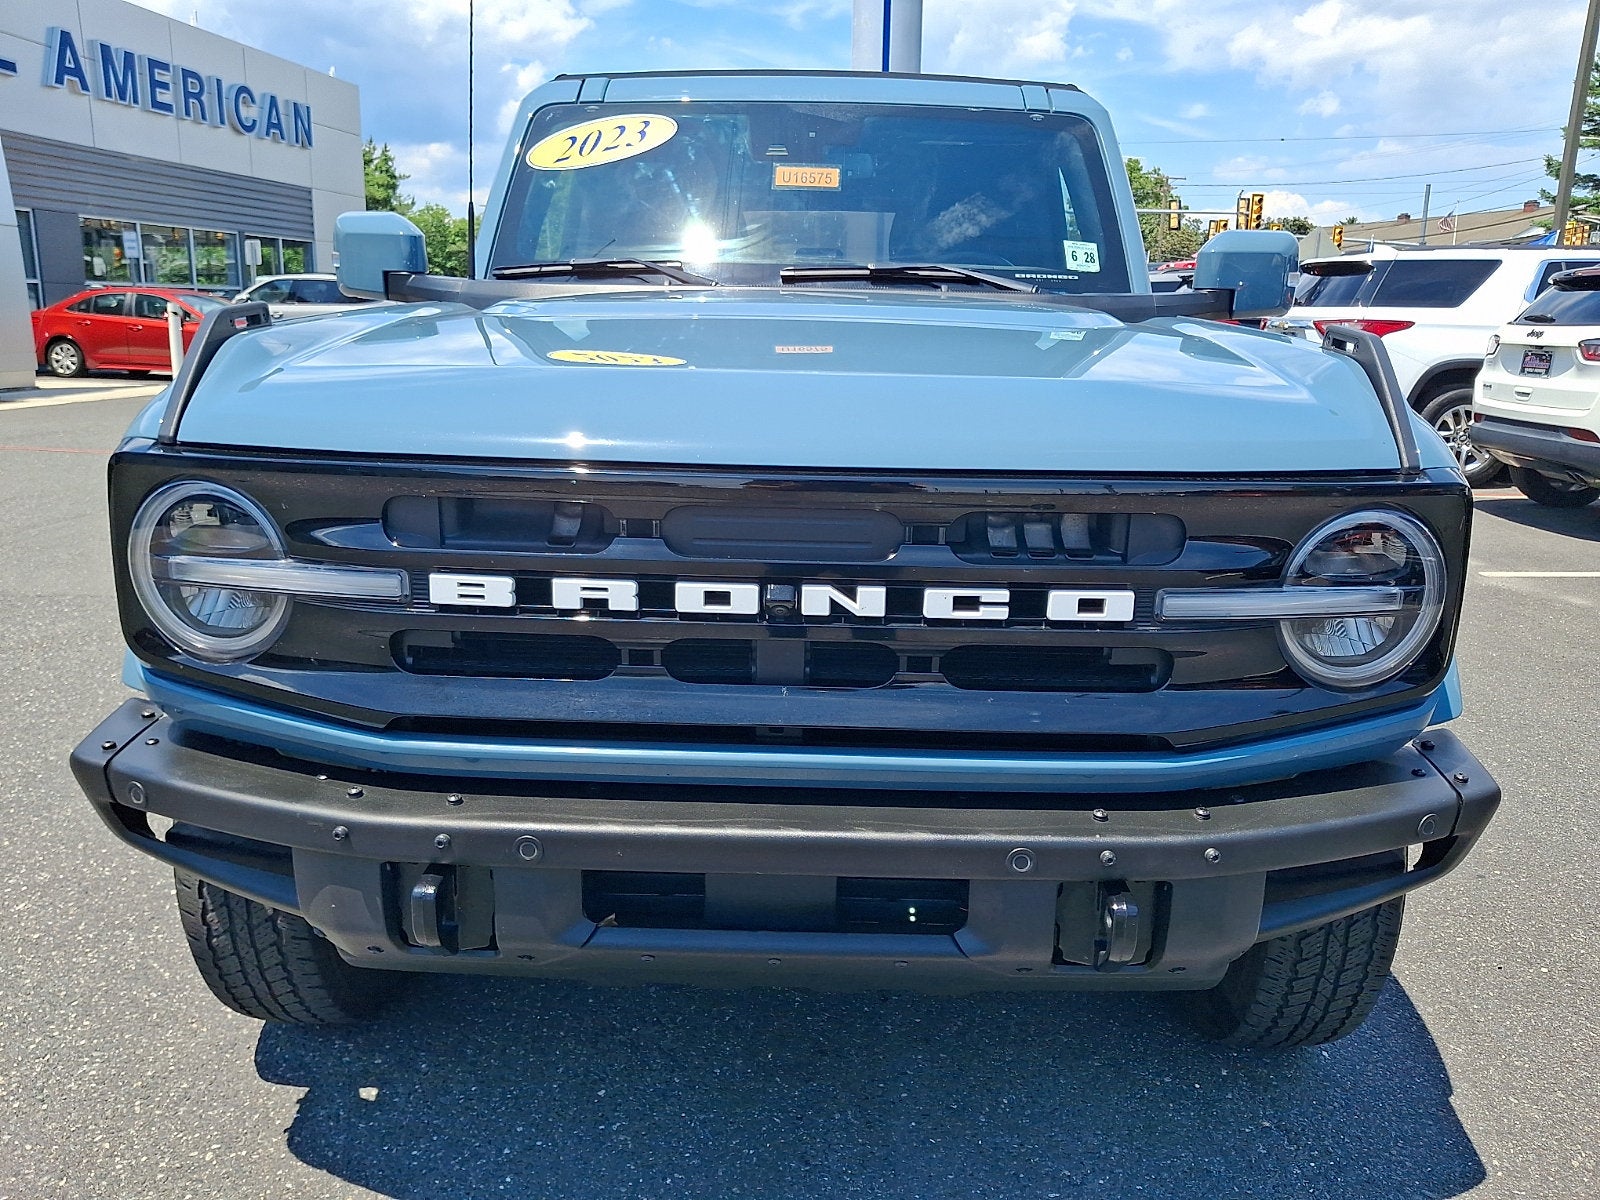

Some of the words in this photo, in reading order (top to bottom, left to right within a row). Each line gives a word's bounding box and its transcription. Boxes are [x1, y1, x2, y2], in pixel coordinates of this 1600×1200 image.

[48, 27, 315, 149] AMERICAN
[553, 120, 651, 164] 2023
[781, 170, 833, 185] U16575
[1071, 250, 1078, 262] 6
[1083, 251, 1096, 264] 28
[428, 572, 1136, 623] BRONCO
